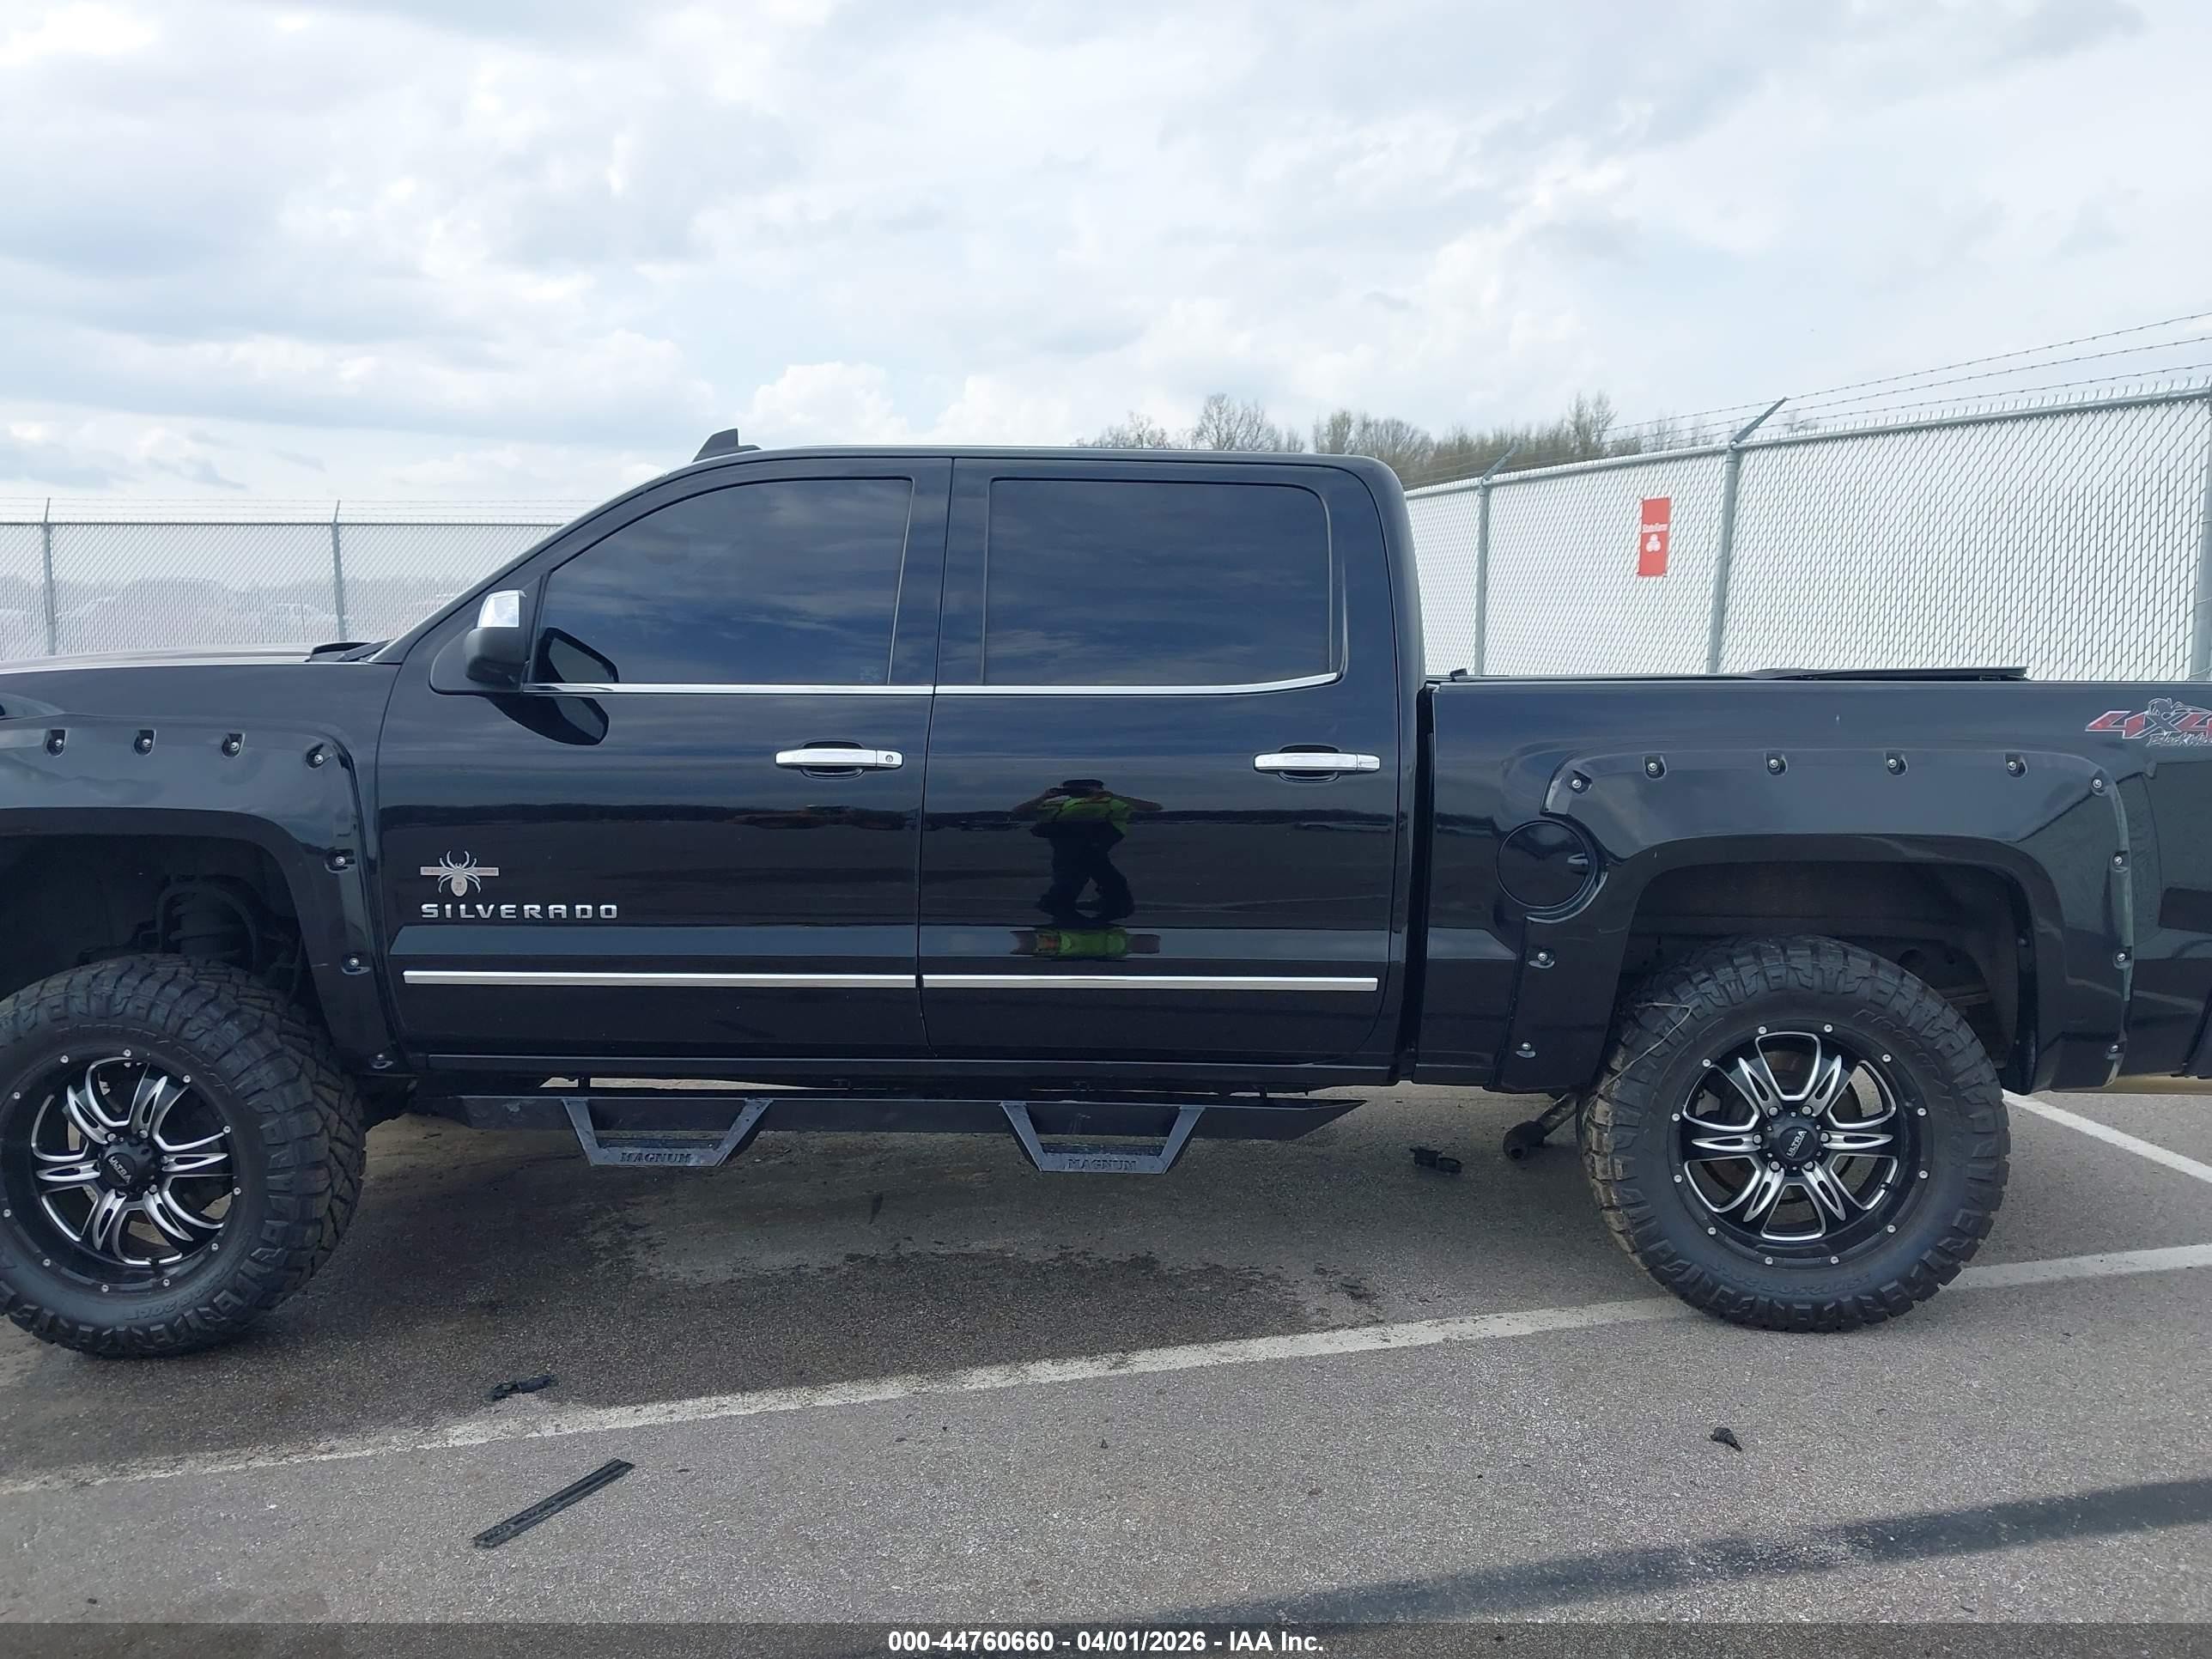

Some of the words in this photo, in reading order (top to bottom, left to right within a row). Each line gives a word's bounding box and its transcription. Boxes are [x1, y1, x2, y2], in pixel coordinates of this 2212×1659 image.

[421, 903, 617, 919] SILVERADO
[1786, 1130, 1808, 1158] ULTRA
[620, 1152, 692, 1164] MAGNUM
[1067, 1158, 1137, 1170] MAGNUM
[108, 1156, 131, 1183] ULTRA
